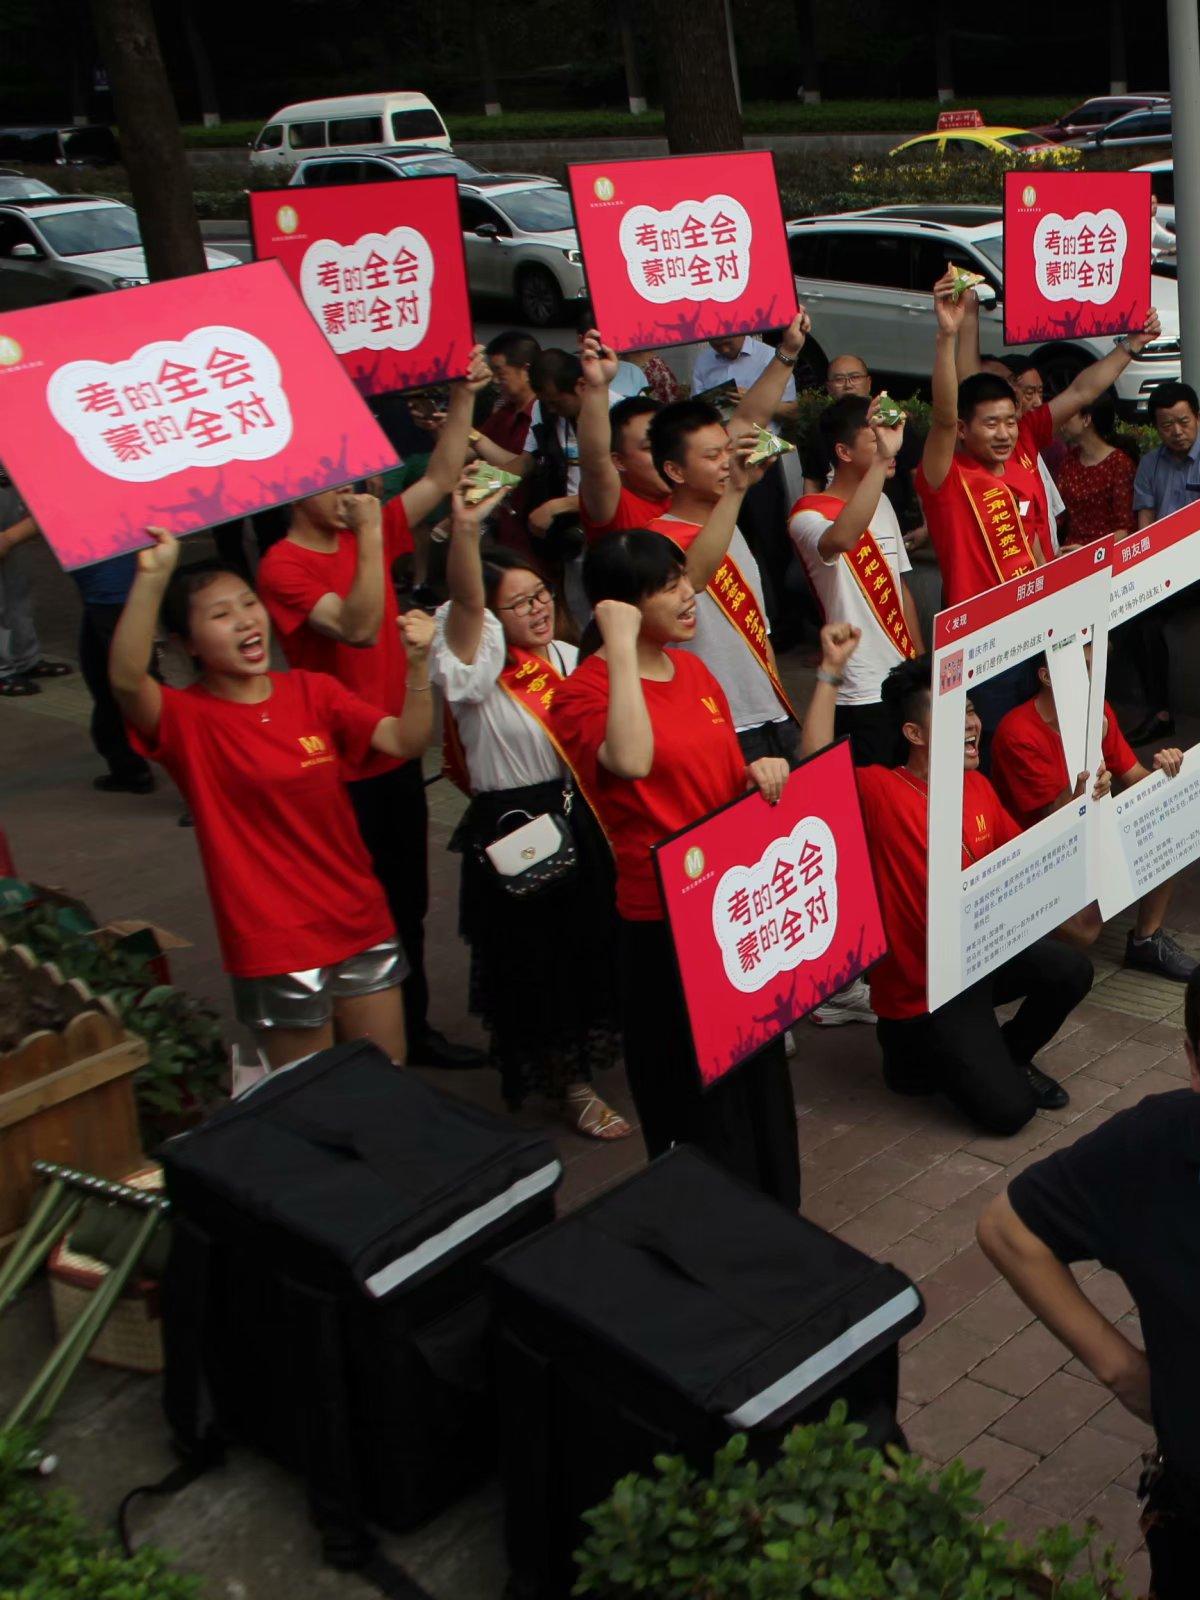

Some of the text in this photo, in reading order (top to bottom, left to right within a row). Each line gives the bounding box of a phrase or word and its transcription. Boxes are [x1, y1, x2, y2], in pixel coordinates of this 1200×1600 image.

[634, 211, 738, 248] 考的全会
[1044, 225, 1117, 255] 考的全会
[315, 245, 419, 295] 考的全会
[642, 249, 740, 288] 蒙的全对
[1045, 257, 1115, 288] 蒙的全对
[322, 289, 420, 334] 蒙的全对
[76, 346, 256, 417] 考的全会
[101, 391, 275, 463] 蒙的全对
[1121, 536, 1151, 563] 朋友圈
[1017, 575, 1044, 602] 朋友圈
[952, 615, 968, 630] 发现
[968, 638, 996, 661] 重庆市民
[975, 814, 986, 833] M
[727, 840, 824, 926] 考的全会
[736, 886, 830, 973] 蒙的全对
